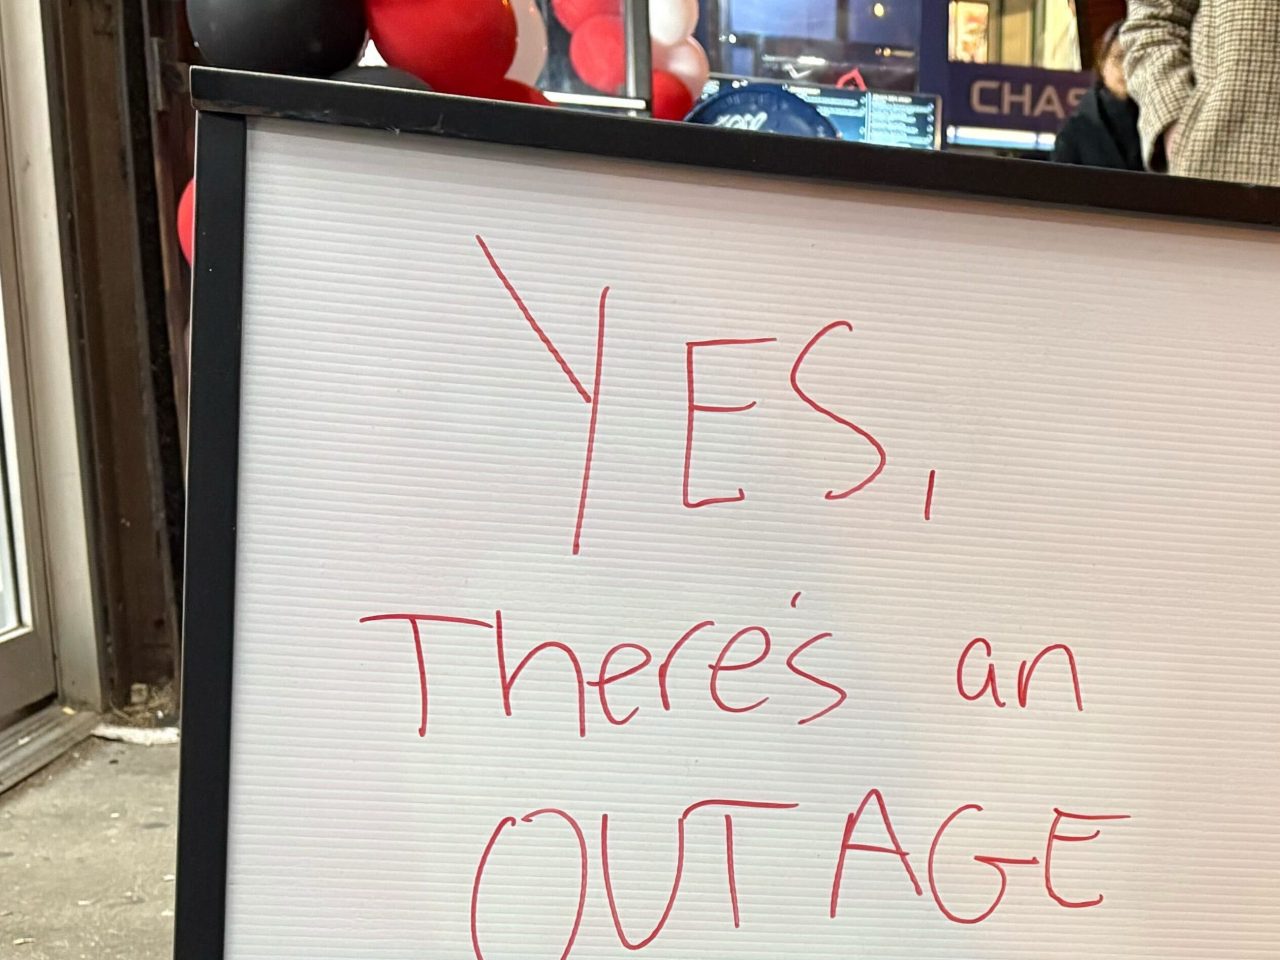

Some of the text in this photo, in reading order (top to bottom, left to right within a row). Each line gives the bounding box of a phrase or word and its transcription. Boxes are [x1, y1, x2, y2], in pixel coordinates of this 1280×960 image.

[970, 80, 1088, 119] CHAS
[477, 237, 936, 554] YES,
[360, 593, 1083, 737] There's an
